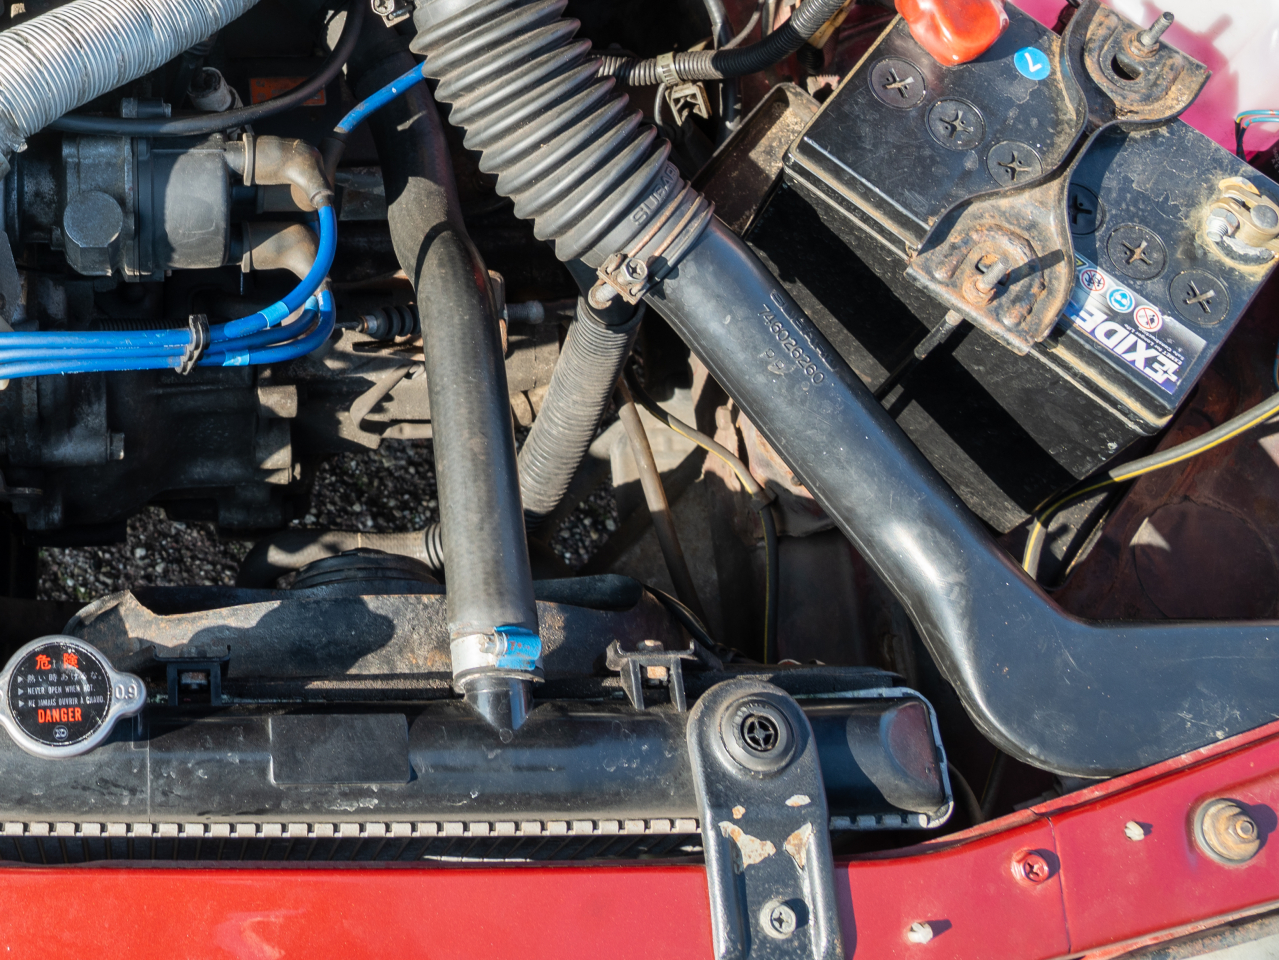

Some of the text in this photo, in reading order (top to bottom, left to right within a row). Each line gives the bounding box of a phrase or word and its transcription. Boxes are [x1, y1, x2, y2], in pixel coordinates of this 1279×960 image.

[1073, 305, 1180, 384] EXIDE
[35, 652, 79, 671] 危険
[27, 686, 45, 695] NEVER
[47, 685, 62, 694] OPEN
[64, 684, 80, 693] WHEN
[115, 683, 138, 700] 0.9
[37, 707, 82, 723] DANGER
